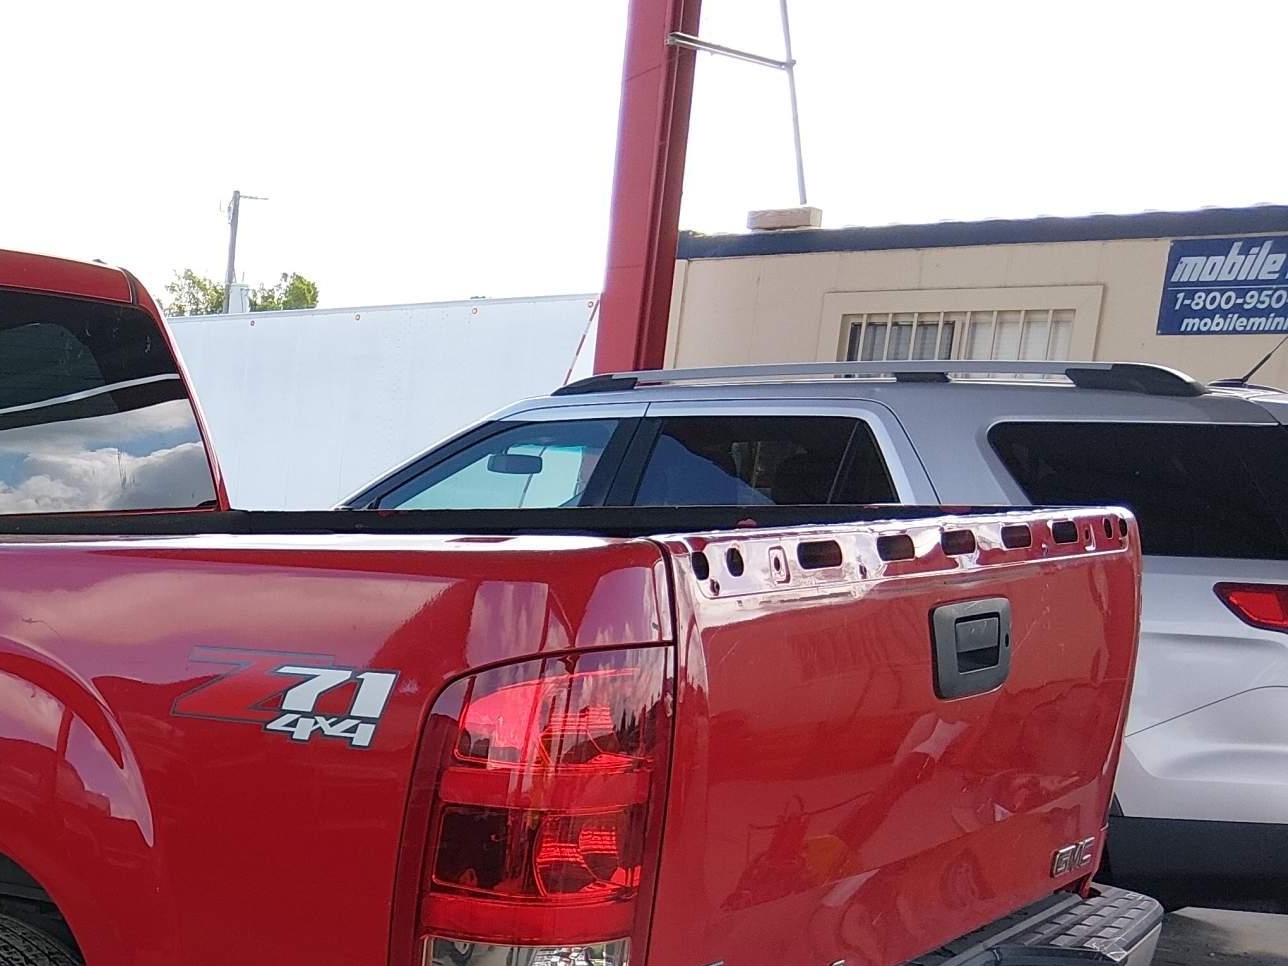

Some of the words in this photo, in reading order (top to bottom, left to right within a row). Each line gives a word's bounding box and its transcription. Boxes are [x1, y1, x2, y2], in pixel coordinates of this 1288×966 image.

[1171, 240, 1286, 282] mobile
[1174, 290, 1288, 311] 1-800-950
[171, 645, 400, 726] Z71
[1052, 836, 1095, 877] GMC
